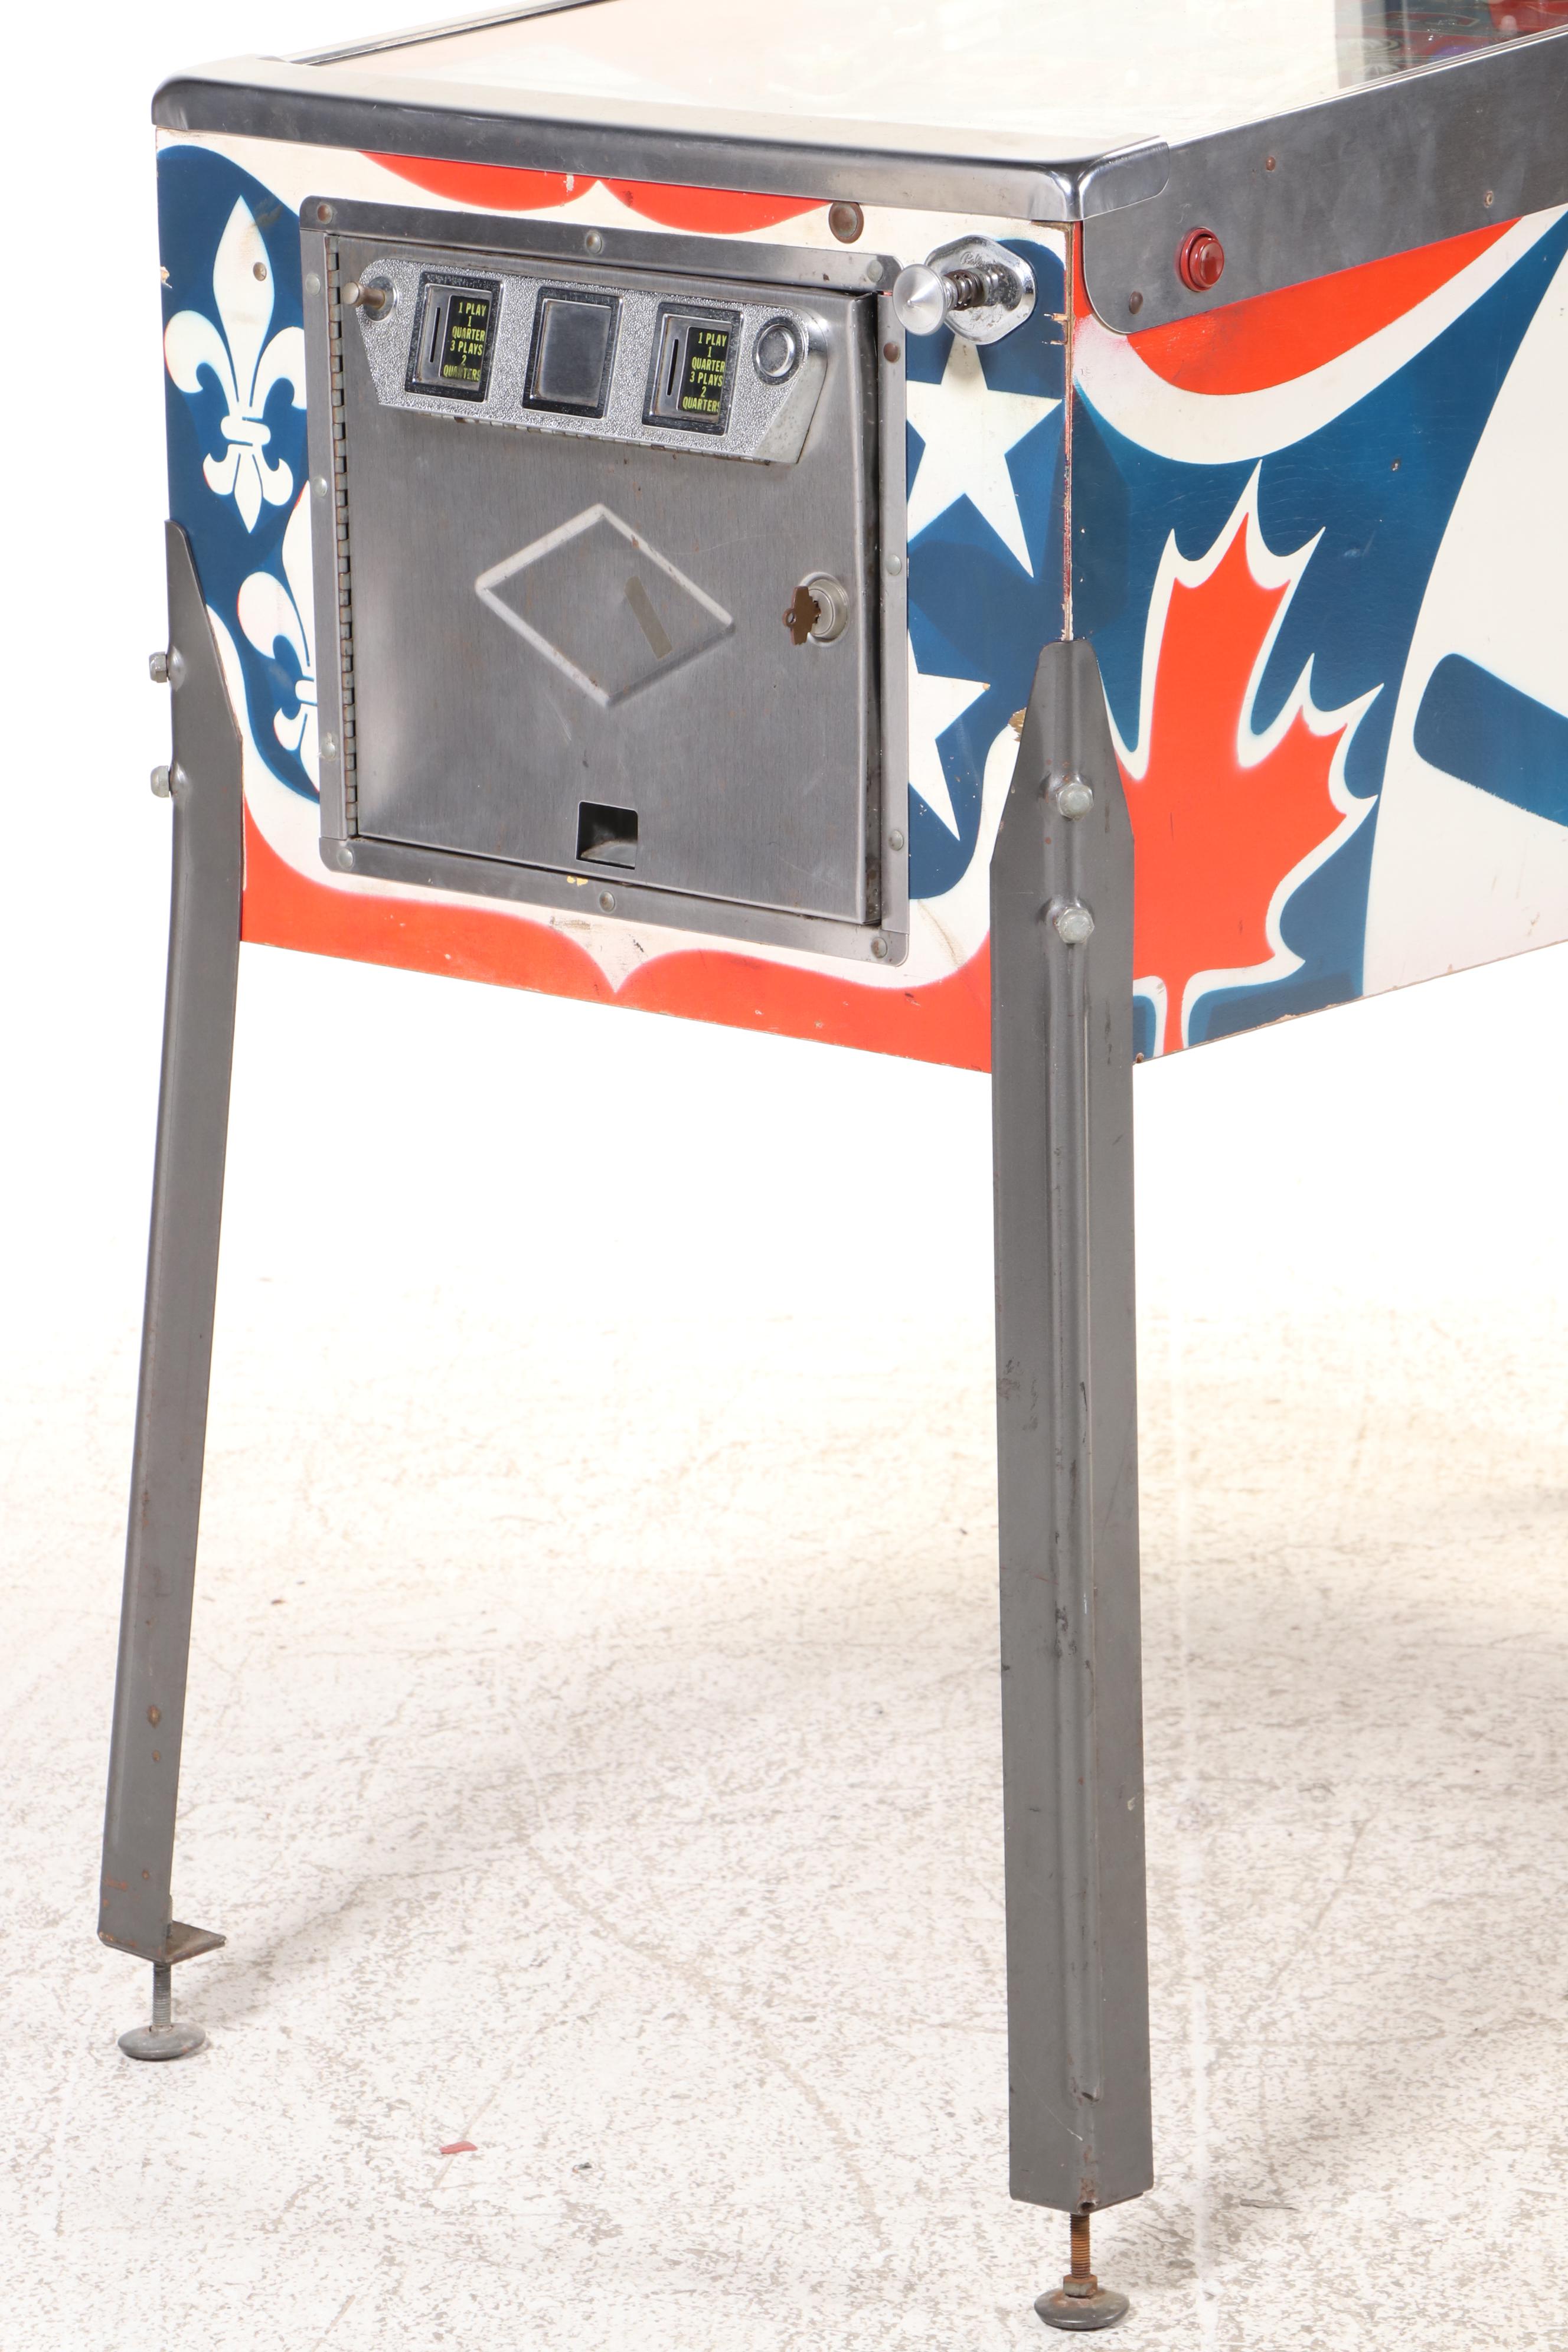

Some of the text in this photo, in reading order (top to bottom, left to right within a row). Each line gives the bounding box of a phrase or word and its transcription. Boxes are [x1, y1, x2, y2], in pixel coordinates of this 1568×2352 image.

[459, 302, 486, 317] 1 PLAY
[467, 315, 472, 326] 1
[452, 326, 485, 341] QUARTER
[698, 332, 727, 347] 1 PLAY
[450, 340, 483, 355] 3 PLAYS
[707, 346, 712, 357] 1
[461, 355, 467, 366] 2
[691, 357, 725, 373] QUARTER
[690, 371, 723, 387] 3 PLAYS
[700, 386, 707, 398] 2
